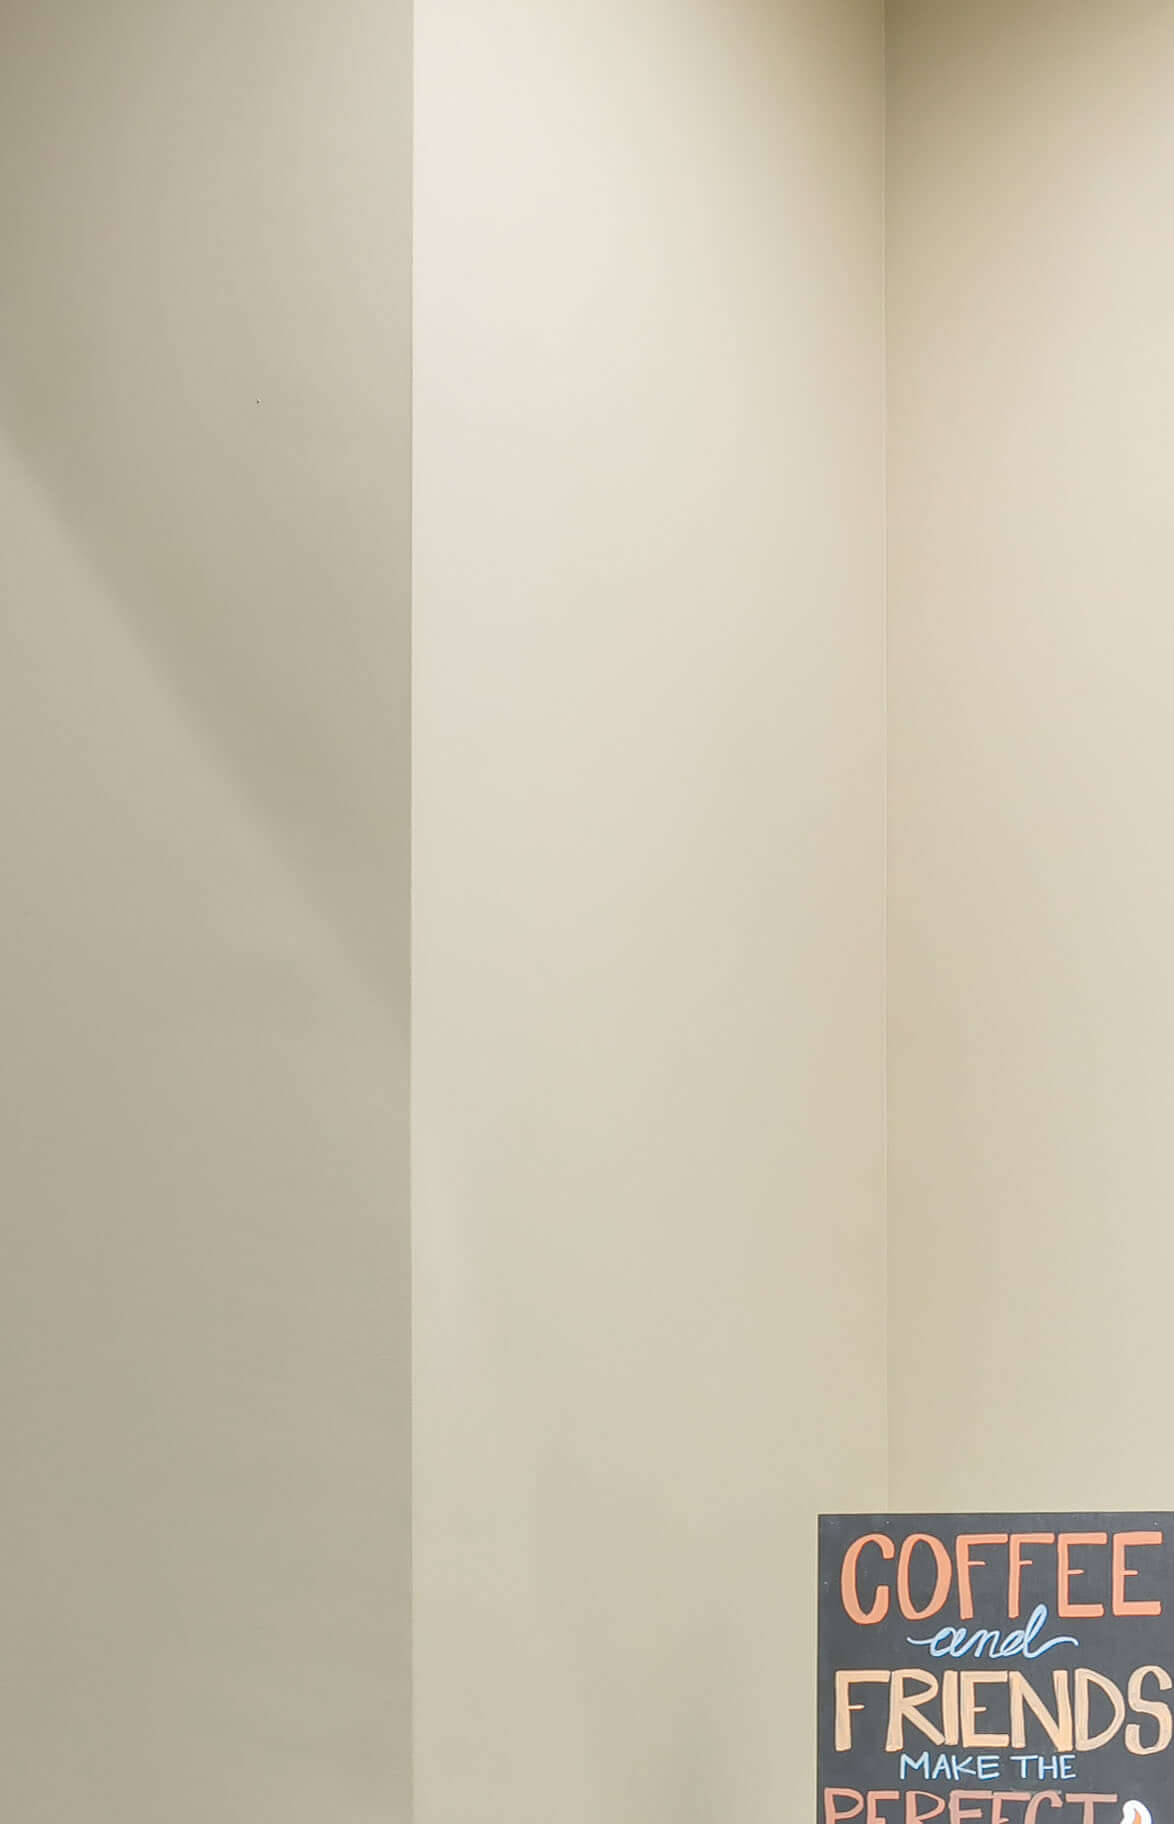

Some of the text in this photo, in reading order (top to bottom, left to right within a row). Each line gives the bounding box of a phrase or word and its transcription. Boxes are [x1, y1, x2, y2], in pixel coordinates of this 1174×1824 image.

[840, 1531, 1164, 1625] COFFEE
[906, 1602, 1080, 1660] and
[834, 1665, 1174, 1756] FRIENDS
[899, 1750, 1078, 1781] MAKE THE
